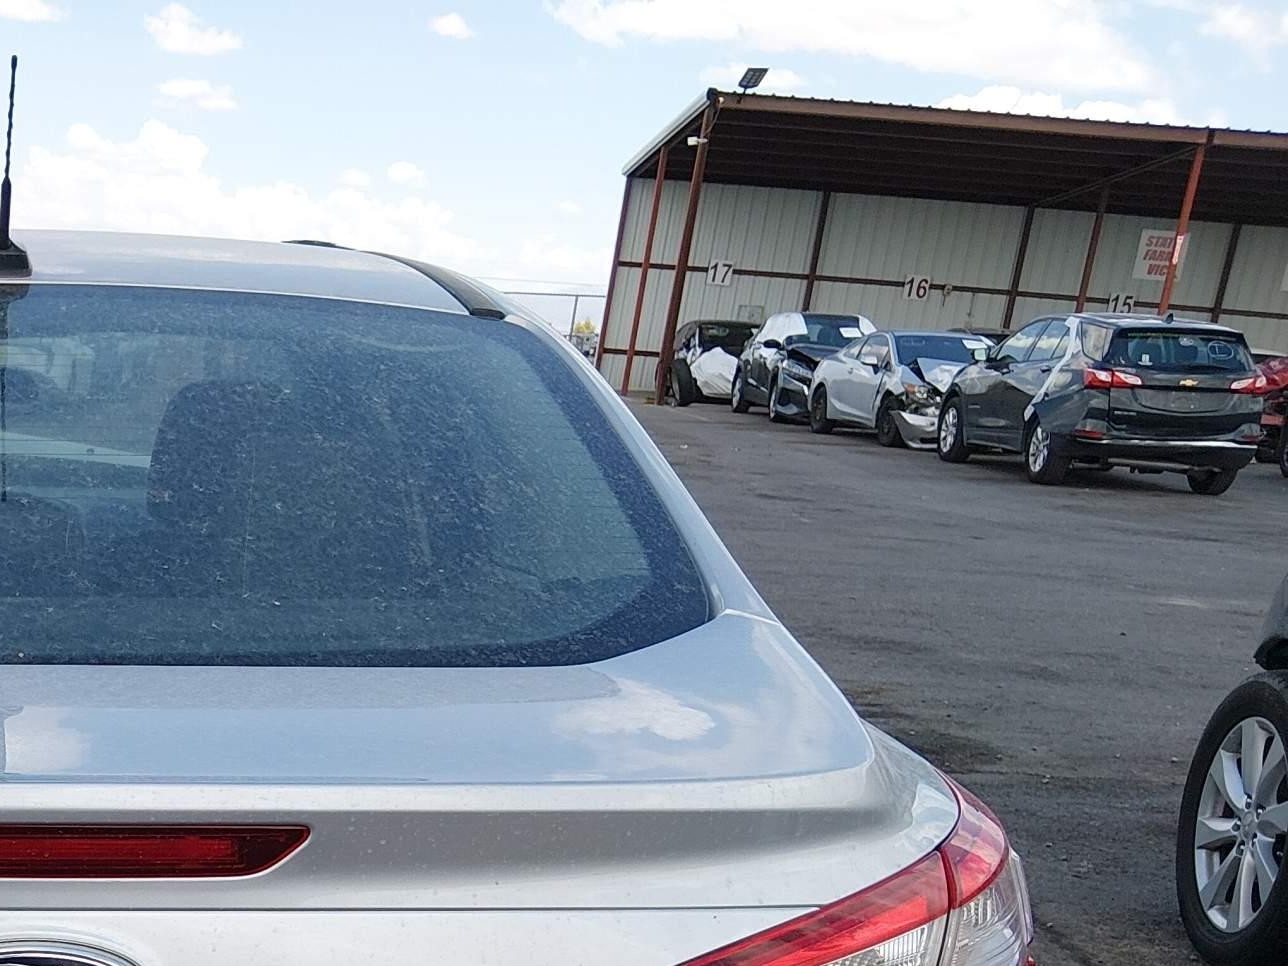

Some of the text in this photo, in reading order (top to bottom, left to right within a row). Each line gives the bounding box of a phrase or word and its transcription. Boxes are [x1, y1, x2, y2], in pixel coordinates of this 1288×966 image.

[1145, 236, 1175, 249] STAT
[711, 262, 733, 283] 17
[906, 277, 929, 299] 16
[1111, 294, 1134, 313] 15
